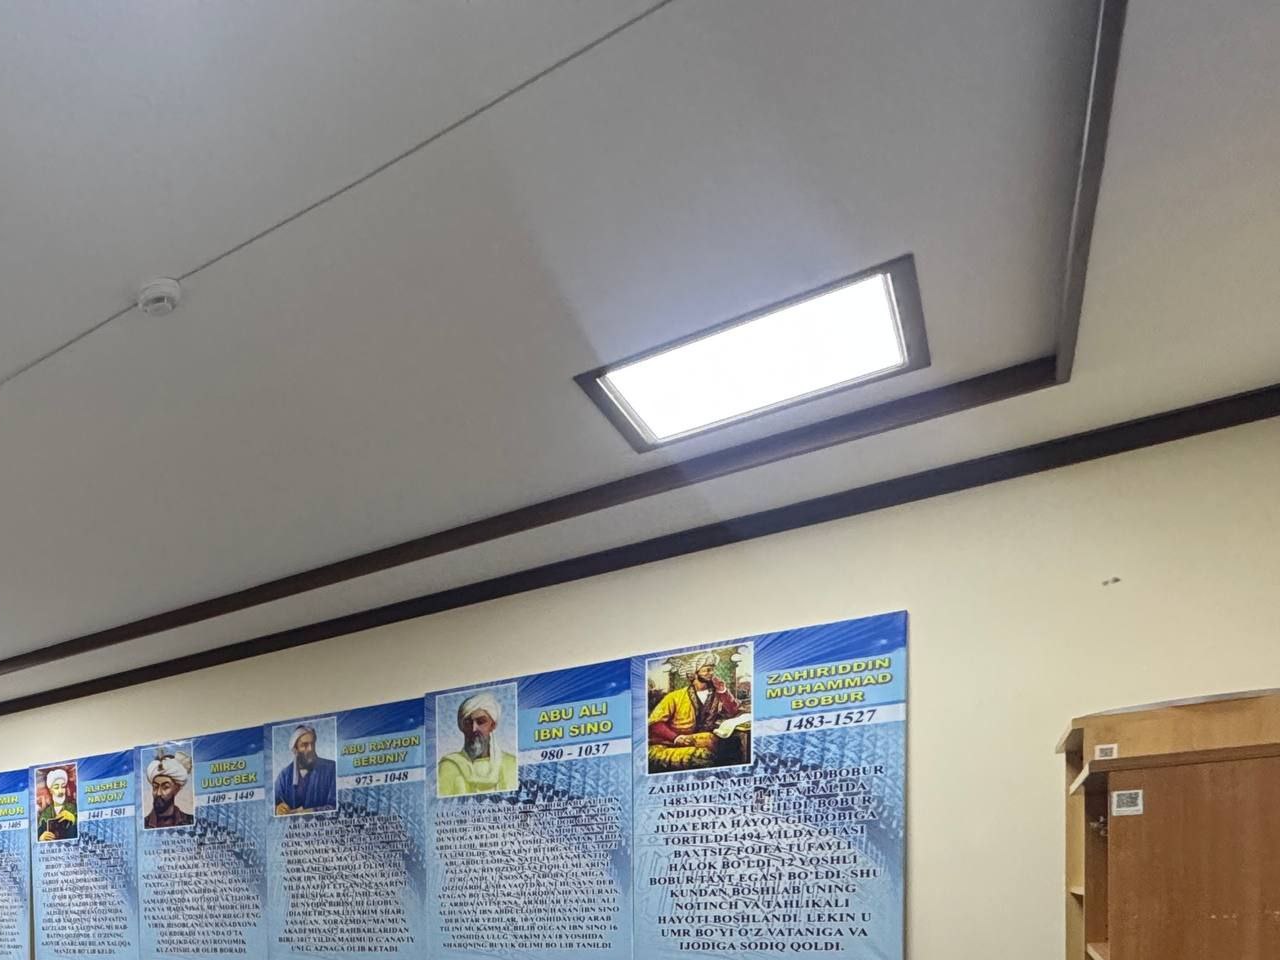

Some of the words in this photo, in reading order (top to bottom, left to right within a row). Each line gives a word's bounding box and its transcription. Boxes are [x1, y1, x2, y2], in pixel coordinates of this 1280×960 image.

[766, 657, 891, 686] ZAHIRIDDIN
[765, 671, 893, 700] MUHAMMAD
[790, 690, 865, 711] BOBUR
[538, 706, 574, 724] ABU
[578, 701, 608, 719] ALI
[784, 709, 877, 733] 1483-1527
[534, 726, 564, 742] IBN
[568, 719, 613, 738] SINO
[342, 742, 366, 756] ABU
[369, 734, 421, 752] RAYHON
[540, 748, 564, 762] 980
[577, 742, 610, 758] 1037
[210, 759, 247, 774] MIRZO
[353, 751, 408, 768] BERUNIY
[85, 779, 128, 794] ALISHER
[355, 775, 373, 787] 973
[384, 771, 409, 783] 1048
[648, 780, 724, 795] ZAHRIDDIN
[730, 770, 823, 788] MUHAMMAD
[829, 765, 885, 779] BOBUR
[87, 791, 125, 805] NAVOIY
[207, 793, 226, 804] 1409
[234, 790, 255, 801] 1449
[663, 791, 753, 806] 1483-YILNING
[778, 781, 867, 797] FEVRALIDA
[88, 810, 104, 820] 1441
[658, 806, 736, 820] ANDIJONDA
[818, 795, 873, 809] BOBUR
[654, 823, 688, 834] JUDA
[692, 821, 727, 831] ERTA
[731, 817, 781, 828] HAYOT
[785, 810, 877, 825] GIRDOBIGA
[818, 825, 865, 837] OTASI
[674, 847, 731, 858] BAXTSIZ
[736, 844, 782, 855] FOJEA
[788, 841, 852, 853] TUFAYLI
[669, 861, 717, 871] HALOK
[781, 858, 794, 867] 12
[799, 855, 858, 866] YOSHLI
[650, 876, 694, 886] BOBUR
[699, 874, 735, 884] TAXT
[739, 872, 782, 883] EGASI
[787, 870, 846, 881] BO'LDI.
[850, 868, 881, 879] SHU
[671, 888, 727, 898] KUNDAN
[732, 885, 801, 896] BOSHLAB
[806, 884, 857, 895] UNING
[676, 901, 738, 910] NOTINCH
[743, 901, 760, 909] VA
[765, 899, 850, 909] TAHLIKALI
[658, 915, 709, 924] HAYOTI
[713, 913, 802, 924] BOSHLANDI.
[807, 913, 856, 923] LEKIN
[861, 912, 872, 922] U
[661, 929, 691, 937] UMR
[695, 928, 734, 937] BO'YI
[738, 928, 764, 937] O'Z
[768, 928, 844, 937] VATANIGA
[848, 927, 869, 937] VA
[680, 942, 737, 951] IJODIGA
[739, 942, 786, 952] SODIQ
[790, 942, 845, 953] QOLDI.
